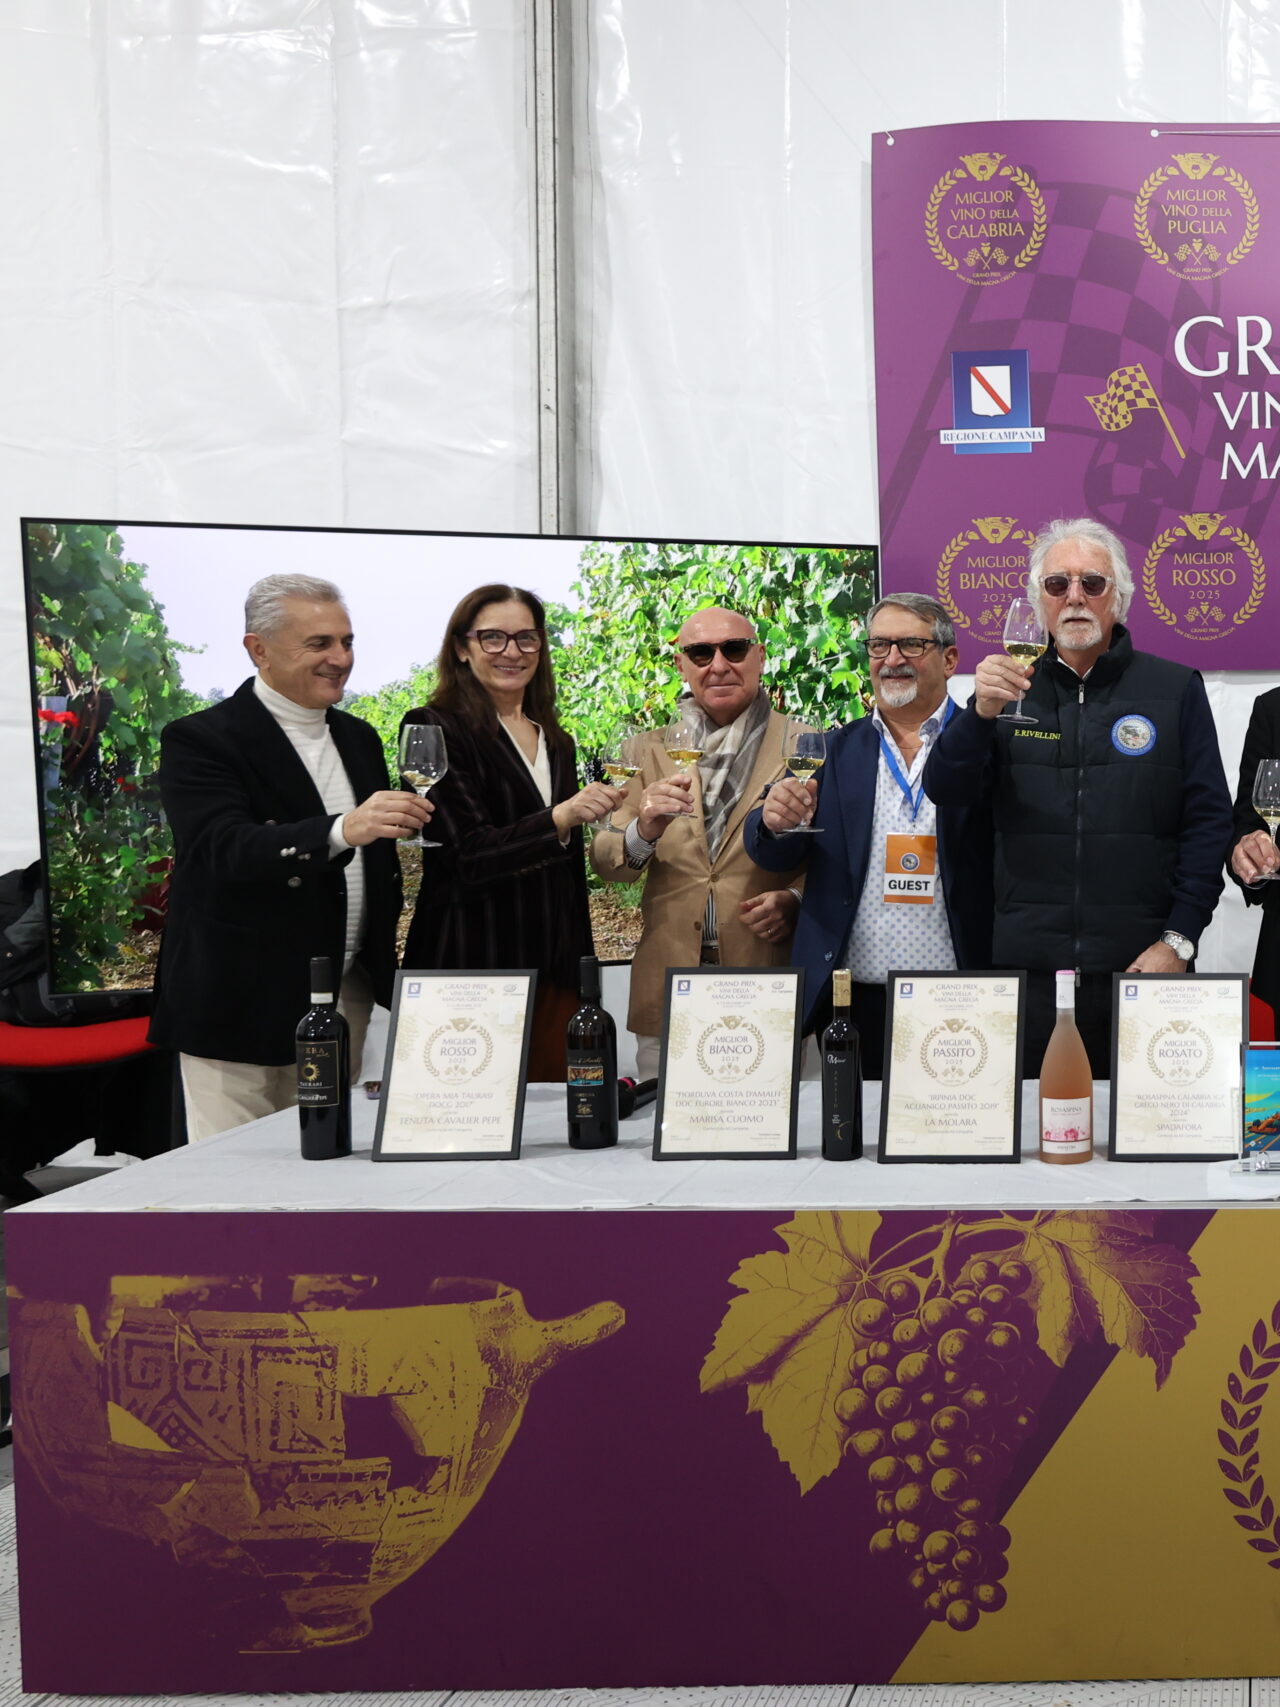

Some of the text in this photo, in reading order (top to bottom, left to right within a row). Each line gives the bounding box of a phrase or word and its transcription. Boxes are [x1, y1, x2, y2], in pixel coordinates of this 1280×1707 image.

[955, 191, 1013, 205] MIGLIOR
[1166, 189, 1227, 201] MIGLIOR
[950, 208, 1019, 221] VINO DELLA
[1161, 205, 1232, 217] VINO DELLA
[947, 223, 1025, 239] CALABRIA
[1168, 220, 1227, 234] PUGLIA
[943, 430, 1043, 443] REGIONE CAMPANIA
[967, 556, 1027, 568] MIGLIOR
[1174, 552, 1234, 565] MIGLIOR
[1173, 569, 1236, 586] ROSSO
[983, 594, 1013, 602] 2025
[1189, 590, 1220, 600] 2025
[888, 880, 930, 892] GUEST
[440, 1046, 477, 1056] ROSSO
[709, 1045, 752, 1055] BIANCO
[933, 1048, 975, 1057] PASSITO
[1159, 1049, 1203, 1058] ROSATO
[689, 1115, 764, 1123] MARISA CUOMO
